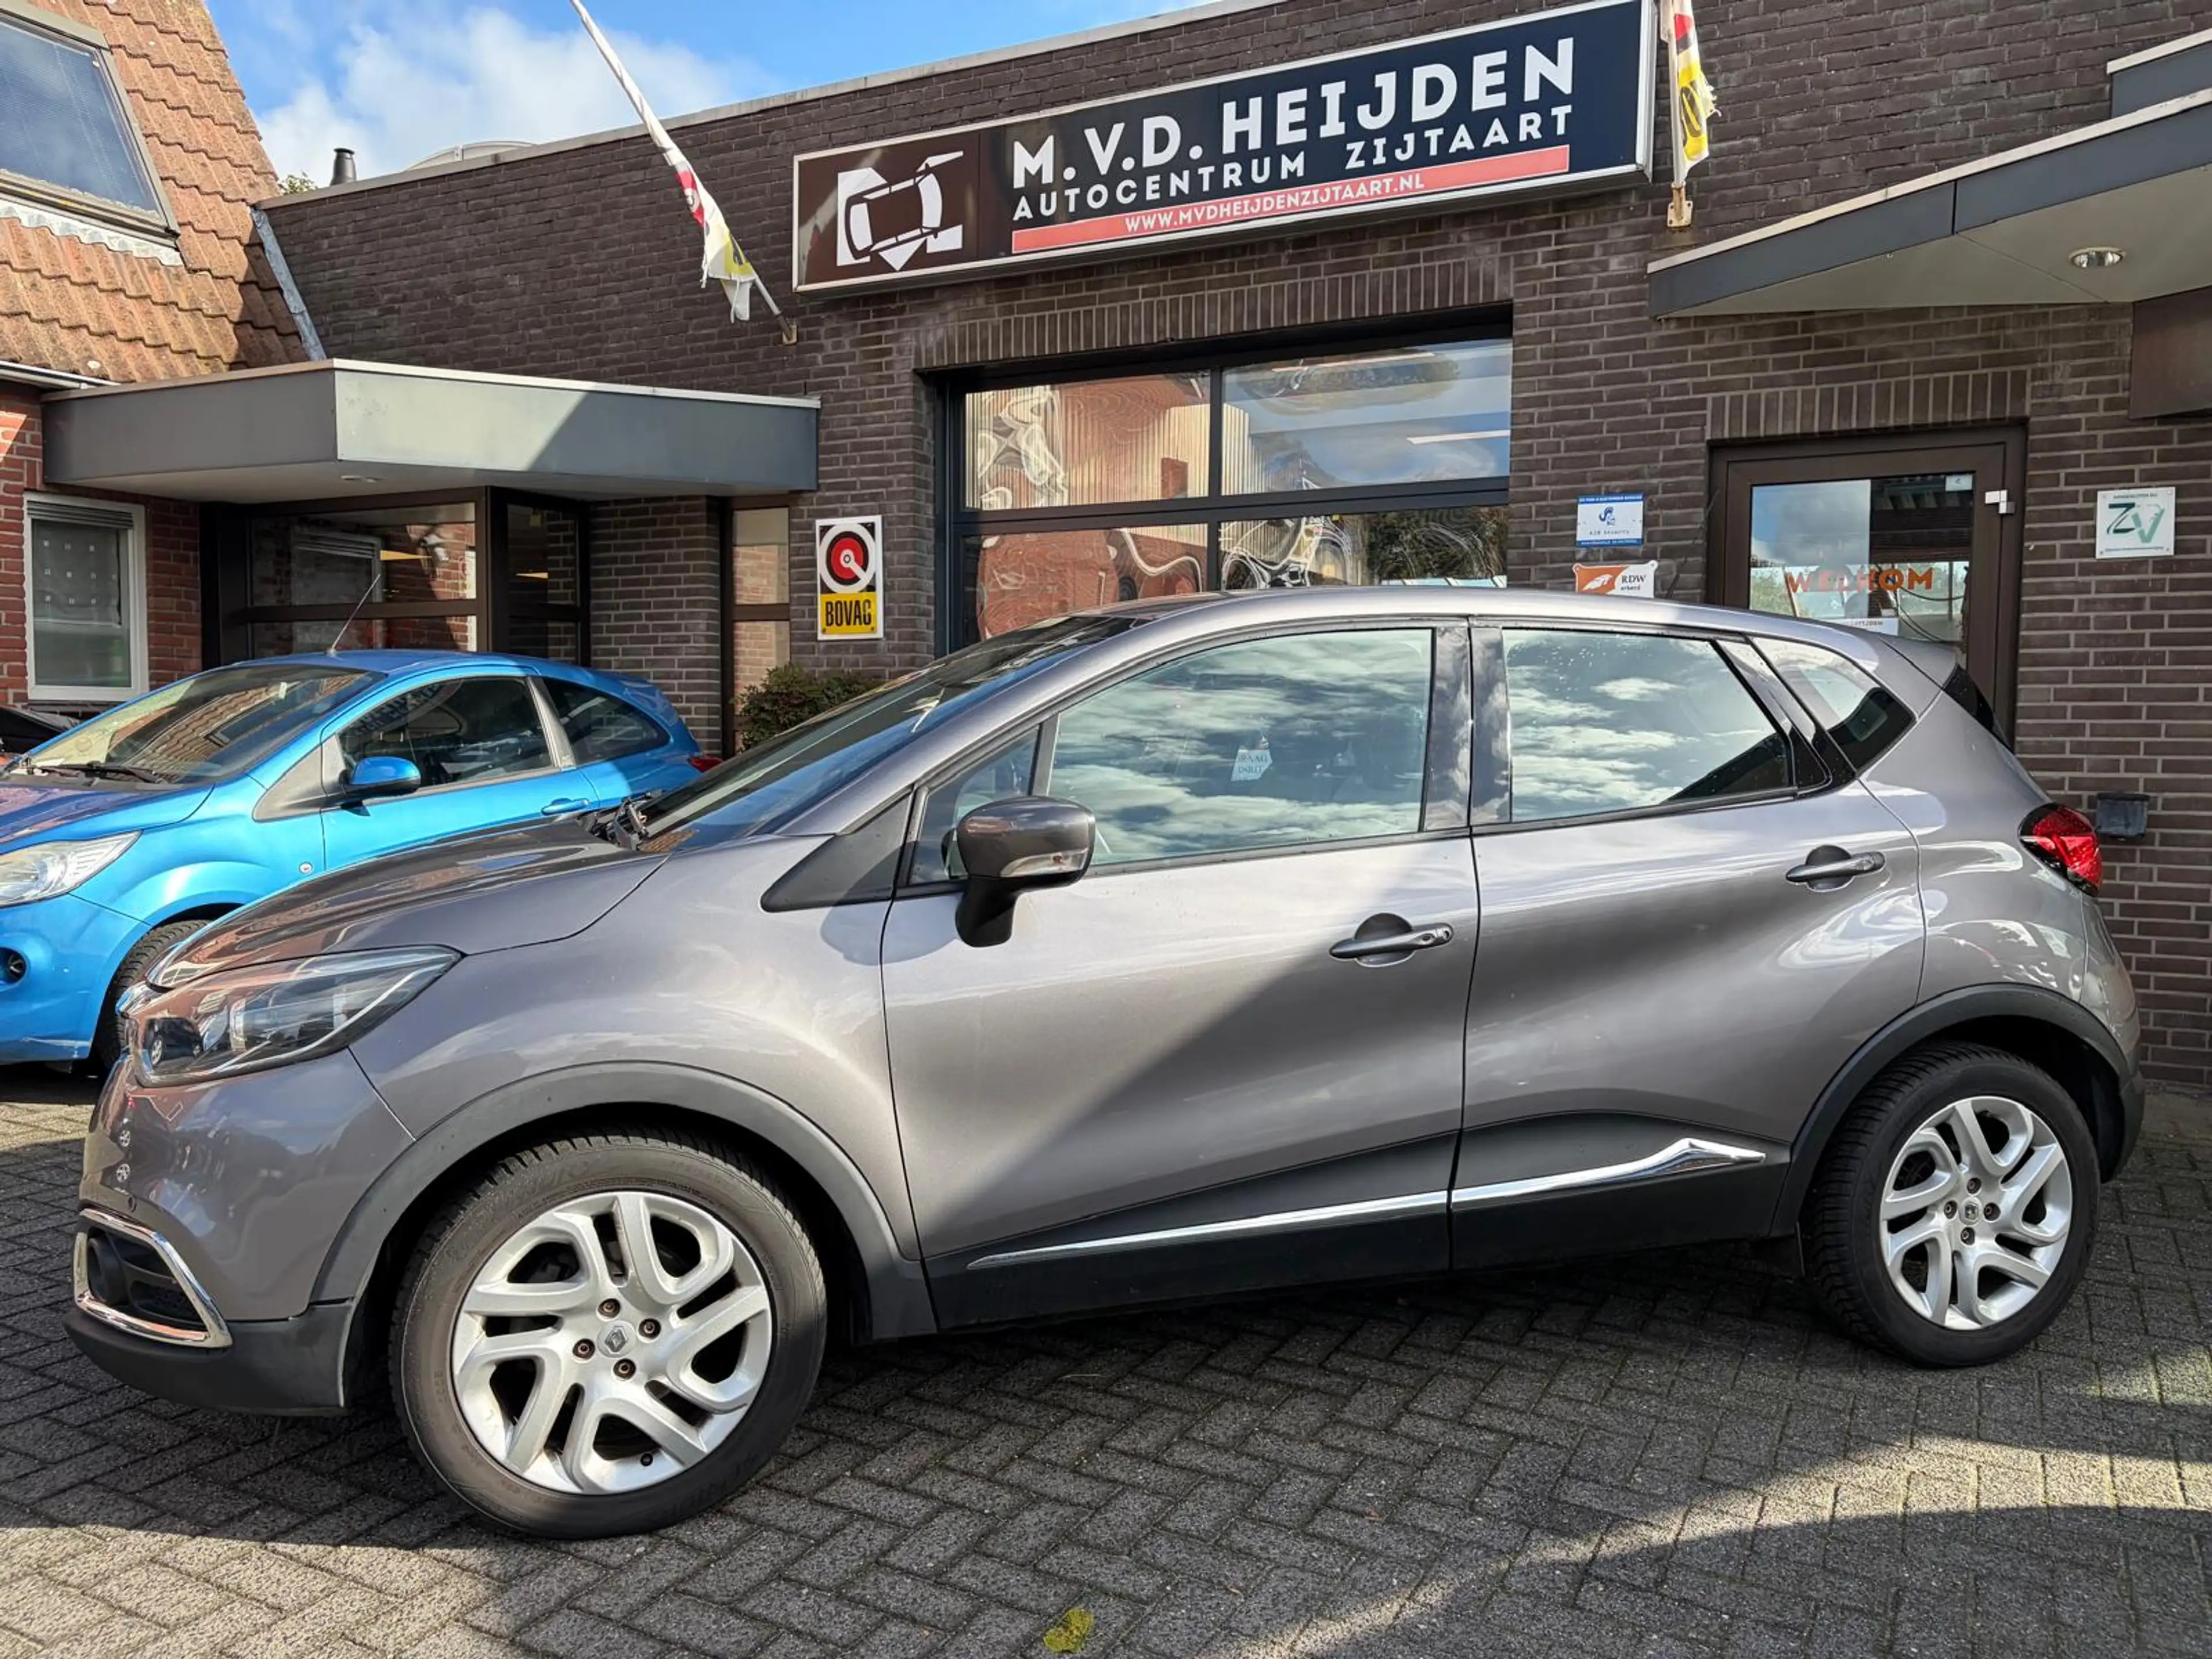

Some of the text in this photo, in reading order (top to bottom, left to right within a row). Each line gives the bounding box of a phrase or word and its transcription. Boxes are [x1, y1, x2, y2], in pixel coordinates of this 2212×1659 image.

[1013, 115, 1203, 189] M.V.D.
[1222, 37, 1574, 154] HEIJDEN
[1013, 104, 1573, 221] AUTOCENTRUM ZIJTAART
[1125, 173, 1425, 233] WWW.MVDHEIJDENZIJTAART.NL
[1621, 574, 1646, 584] RDW
[825, 599, 872, 627] BOVAG
